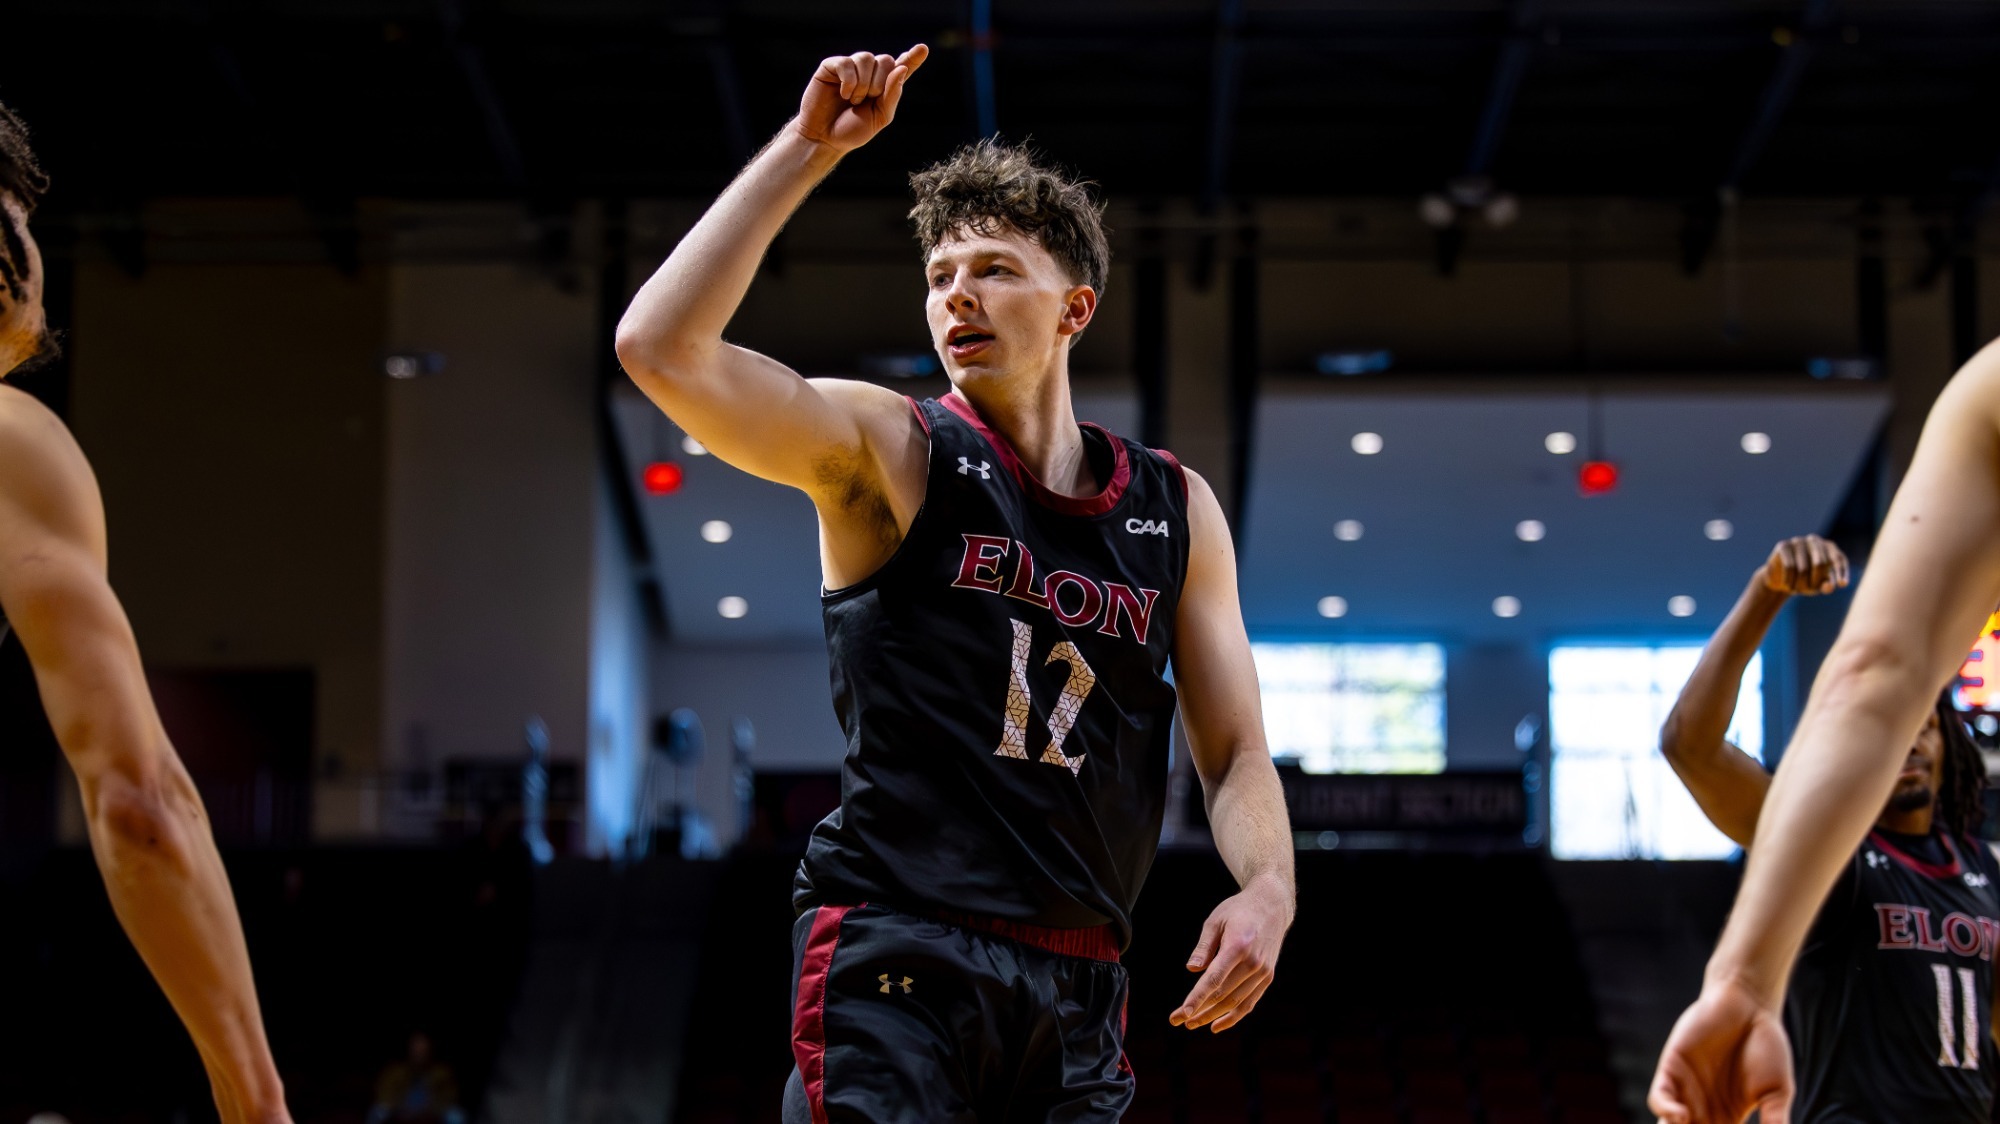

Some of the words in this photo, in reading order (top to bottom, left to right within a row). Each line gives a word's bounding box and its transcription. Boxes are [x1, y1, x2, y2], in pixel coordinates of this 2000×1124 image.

[1125, 519, 1169, 537] CAA
[951, 534, 1160, 644] ELON
[994, 618, 1096, 777] 12
[1931, 965, 1979, 1069] 11
